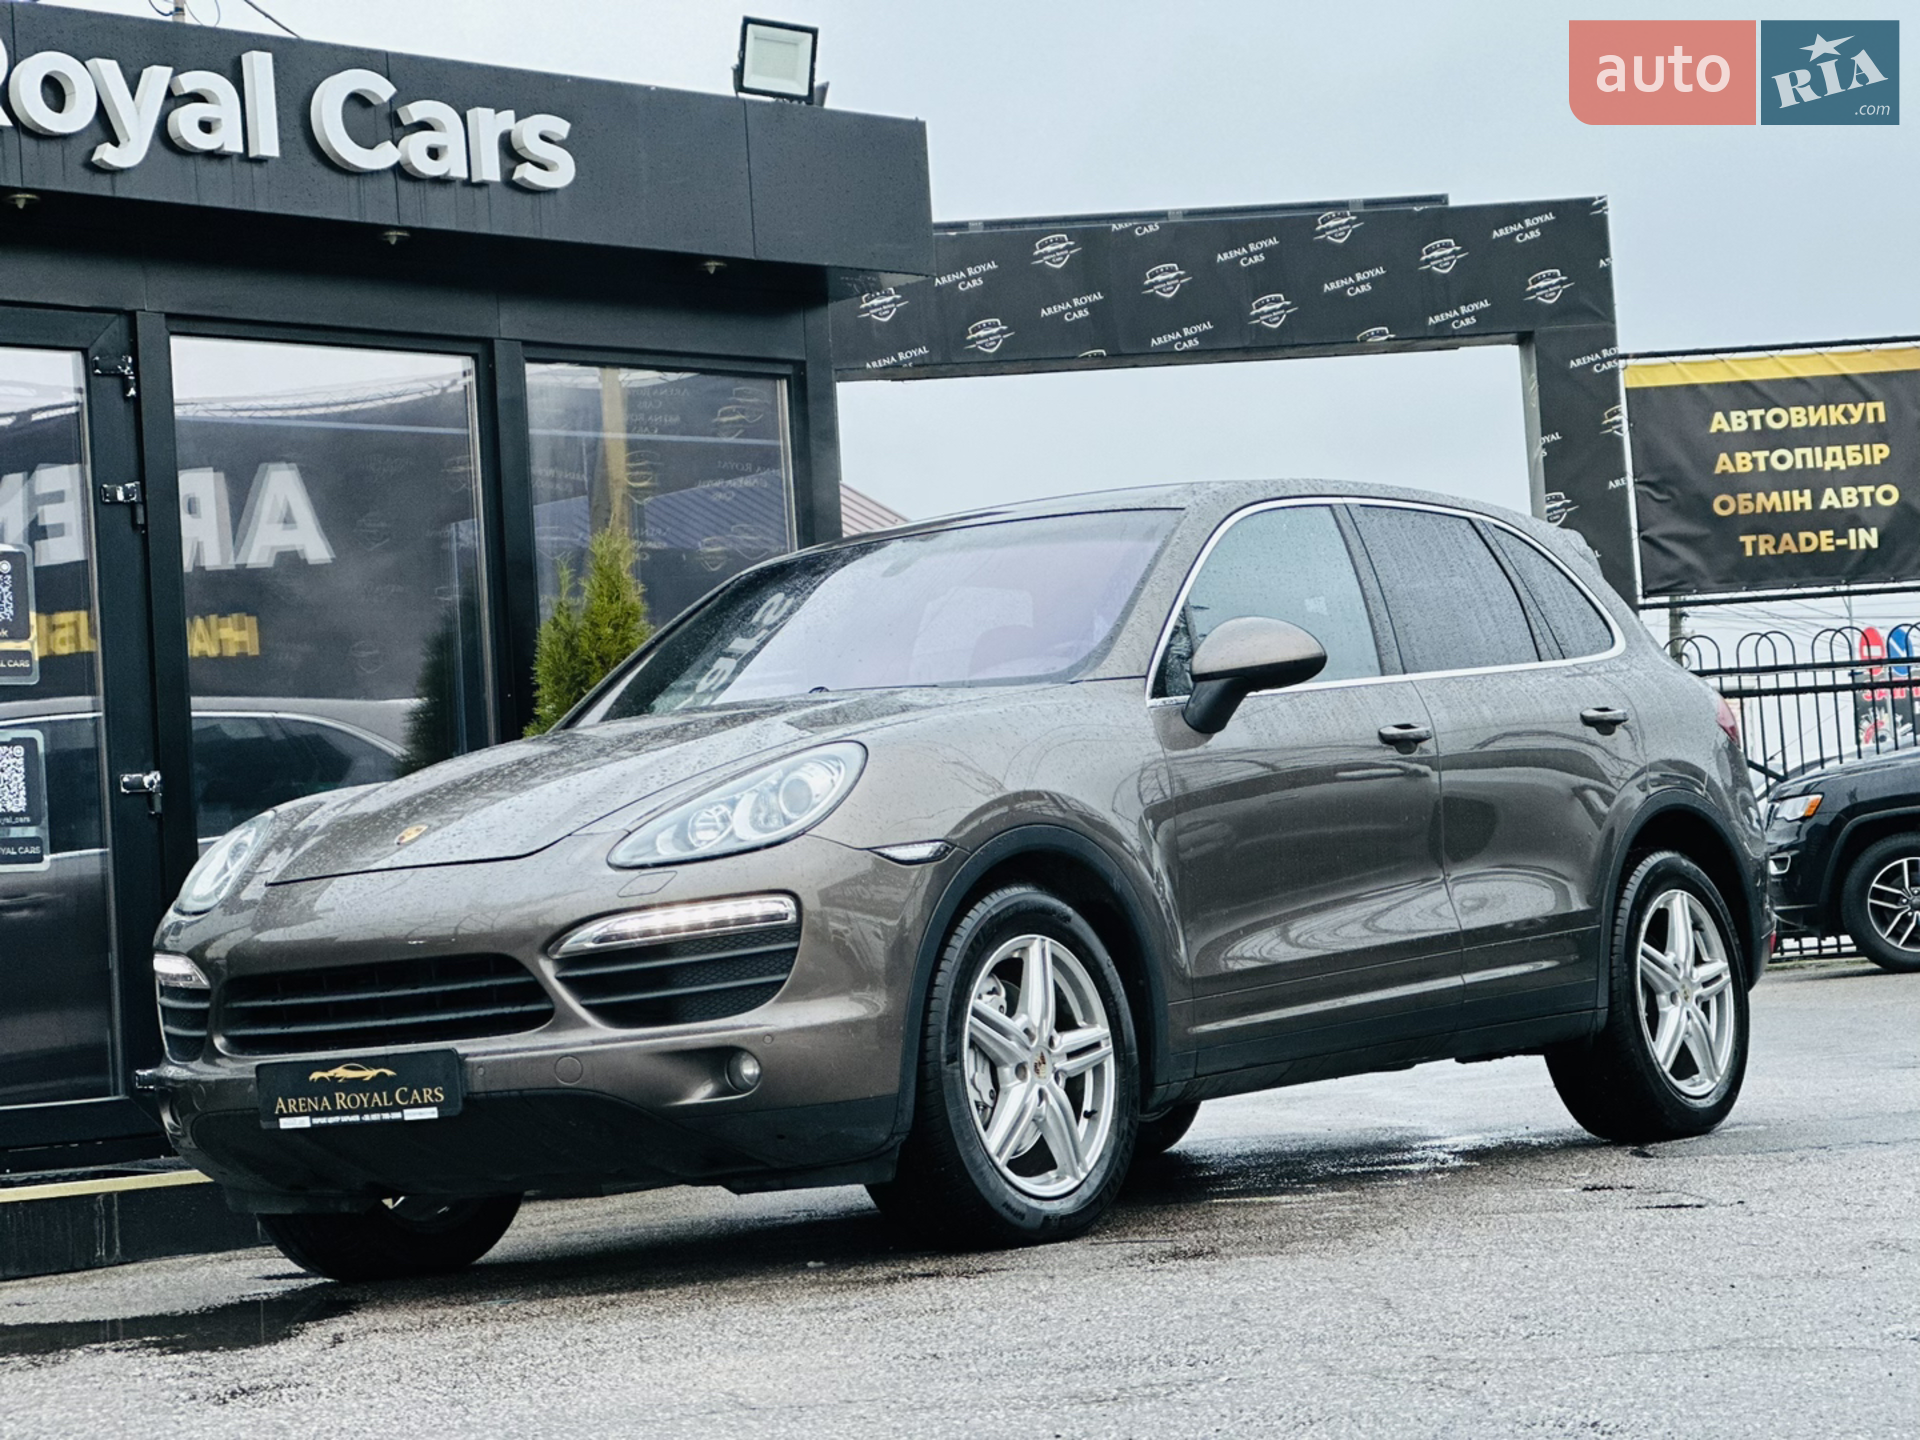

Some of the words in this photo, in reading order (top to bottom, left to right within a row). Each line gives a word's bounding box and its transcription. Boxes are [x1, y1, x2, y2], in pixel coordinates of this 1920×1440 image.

[310, 69, 576, 191] Cars
[1492, 222, 1524, 240] ARENA
[1524, 211, 1556, 228] ROYAL
[1515, 228, 1541, 243] CARS
[1216, 246, 1248, 263] ARENA
[1248, 236, 1280, 252] ROYAL
[1240, 252, 1265, 267] CARS
[935, 270, 967, 287] ARENA
[967, 260, 999, 277] ROYAL
[958, 277, 984, 291] CARS
[1323, 276, 1355, 293] ARENA
[1355, 266, 1387, 282] ROYAL
[1346, 282, 1372, 297] CARS
[1040, 301, 1072, 318] ARENA
[1072, 291, 1104, 307] ROYAL
[1064, 307, 1089, 322] CARS
[1428, 309, 1460, 326] ARENA
[1459, 299, 1491, 315] ROYAL
[1151, 331, 1182, 347] ARENA
[1182, 321, 1214, 337] ROYAL
[1451, 315, 1477, 330] CARS
[1174, 337, 1199, 351] CARS
[1601, 346, 1618, 359] RO
[1709, 401, 1886, 433] АВТОВИКУП
[1714, 443, 1890, 474] АВТОПІДБІР
[1608, 477, 1628, 490] ARE
[1712, 489, 1812, 516] ОБМІН
[1819, 484, 1900, 509] АВТО
[1739, 527, 1879, 556] TRADE-IN
[274, 1096, 333, 1115] ARENA
[335, 1091, 393, 1110] ROYAL
[395, 1086, 445, 1105] CARS
